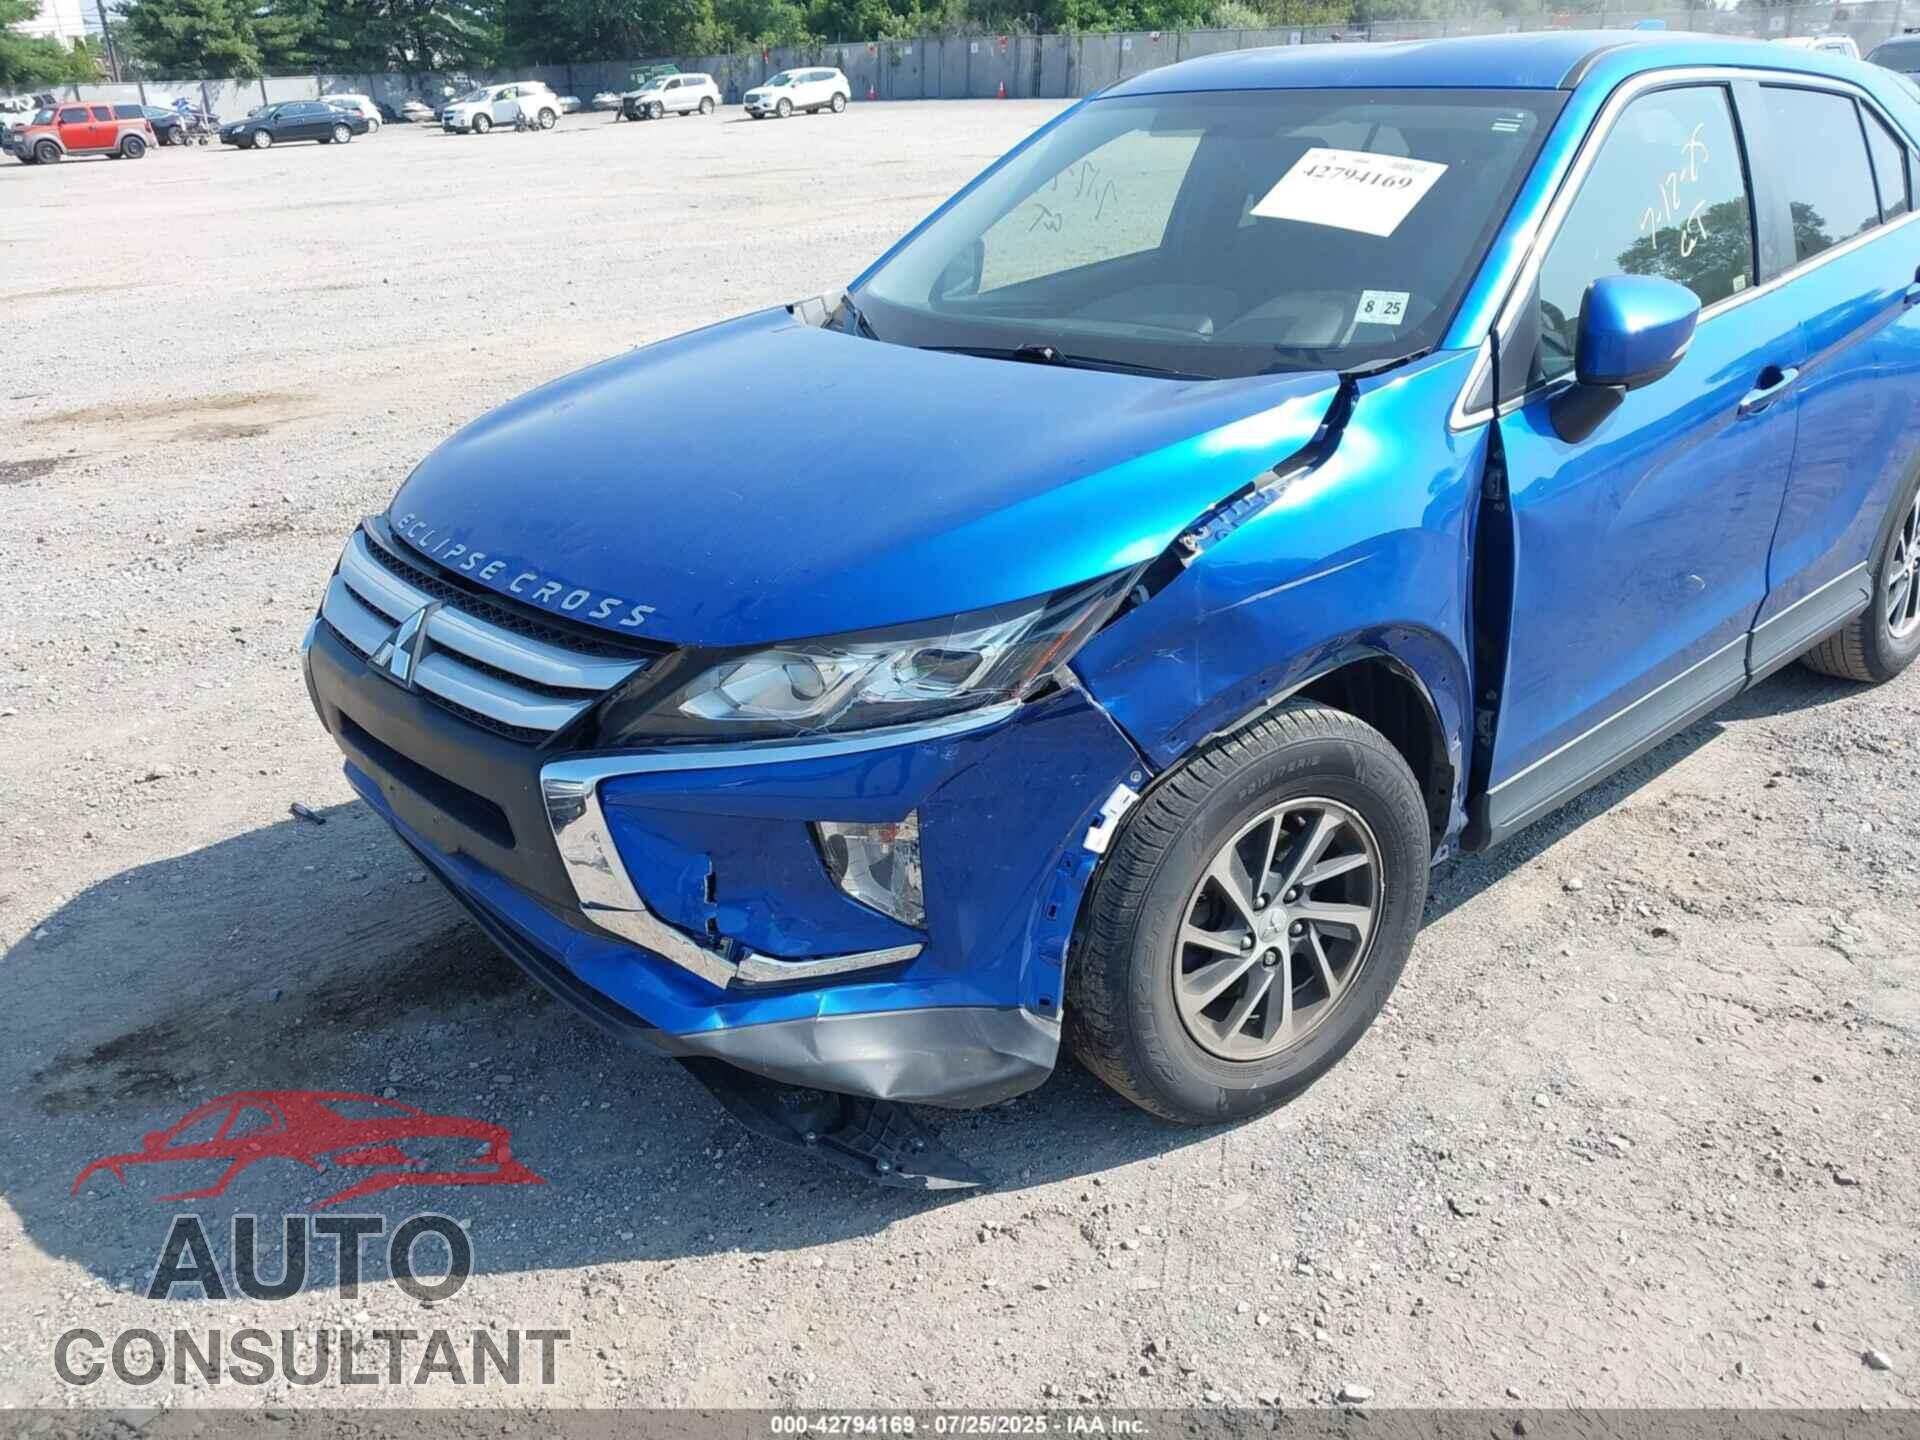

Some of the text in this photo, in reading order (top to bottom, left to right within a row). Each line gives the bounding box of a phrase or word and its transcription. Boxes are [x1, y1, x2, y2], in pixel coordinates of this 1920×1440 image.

[1303, 164, 1414, 190] 42794169
[1364, 300, 1401, 315] 8 25
[398, 512, 656, 627] ECLIPSE CROSS
